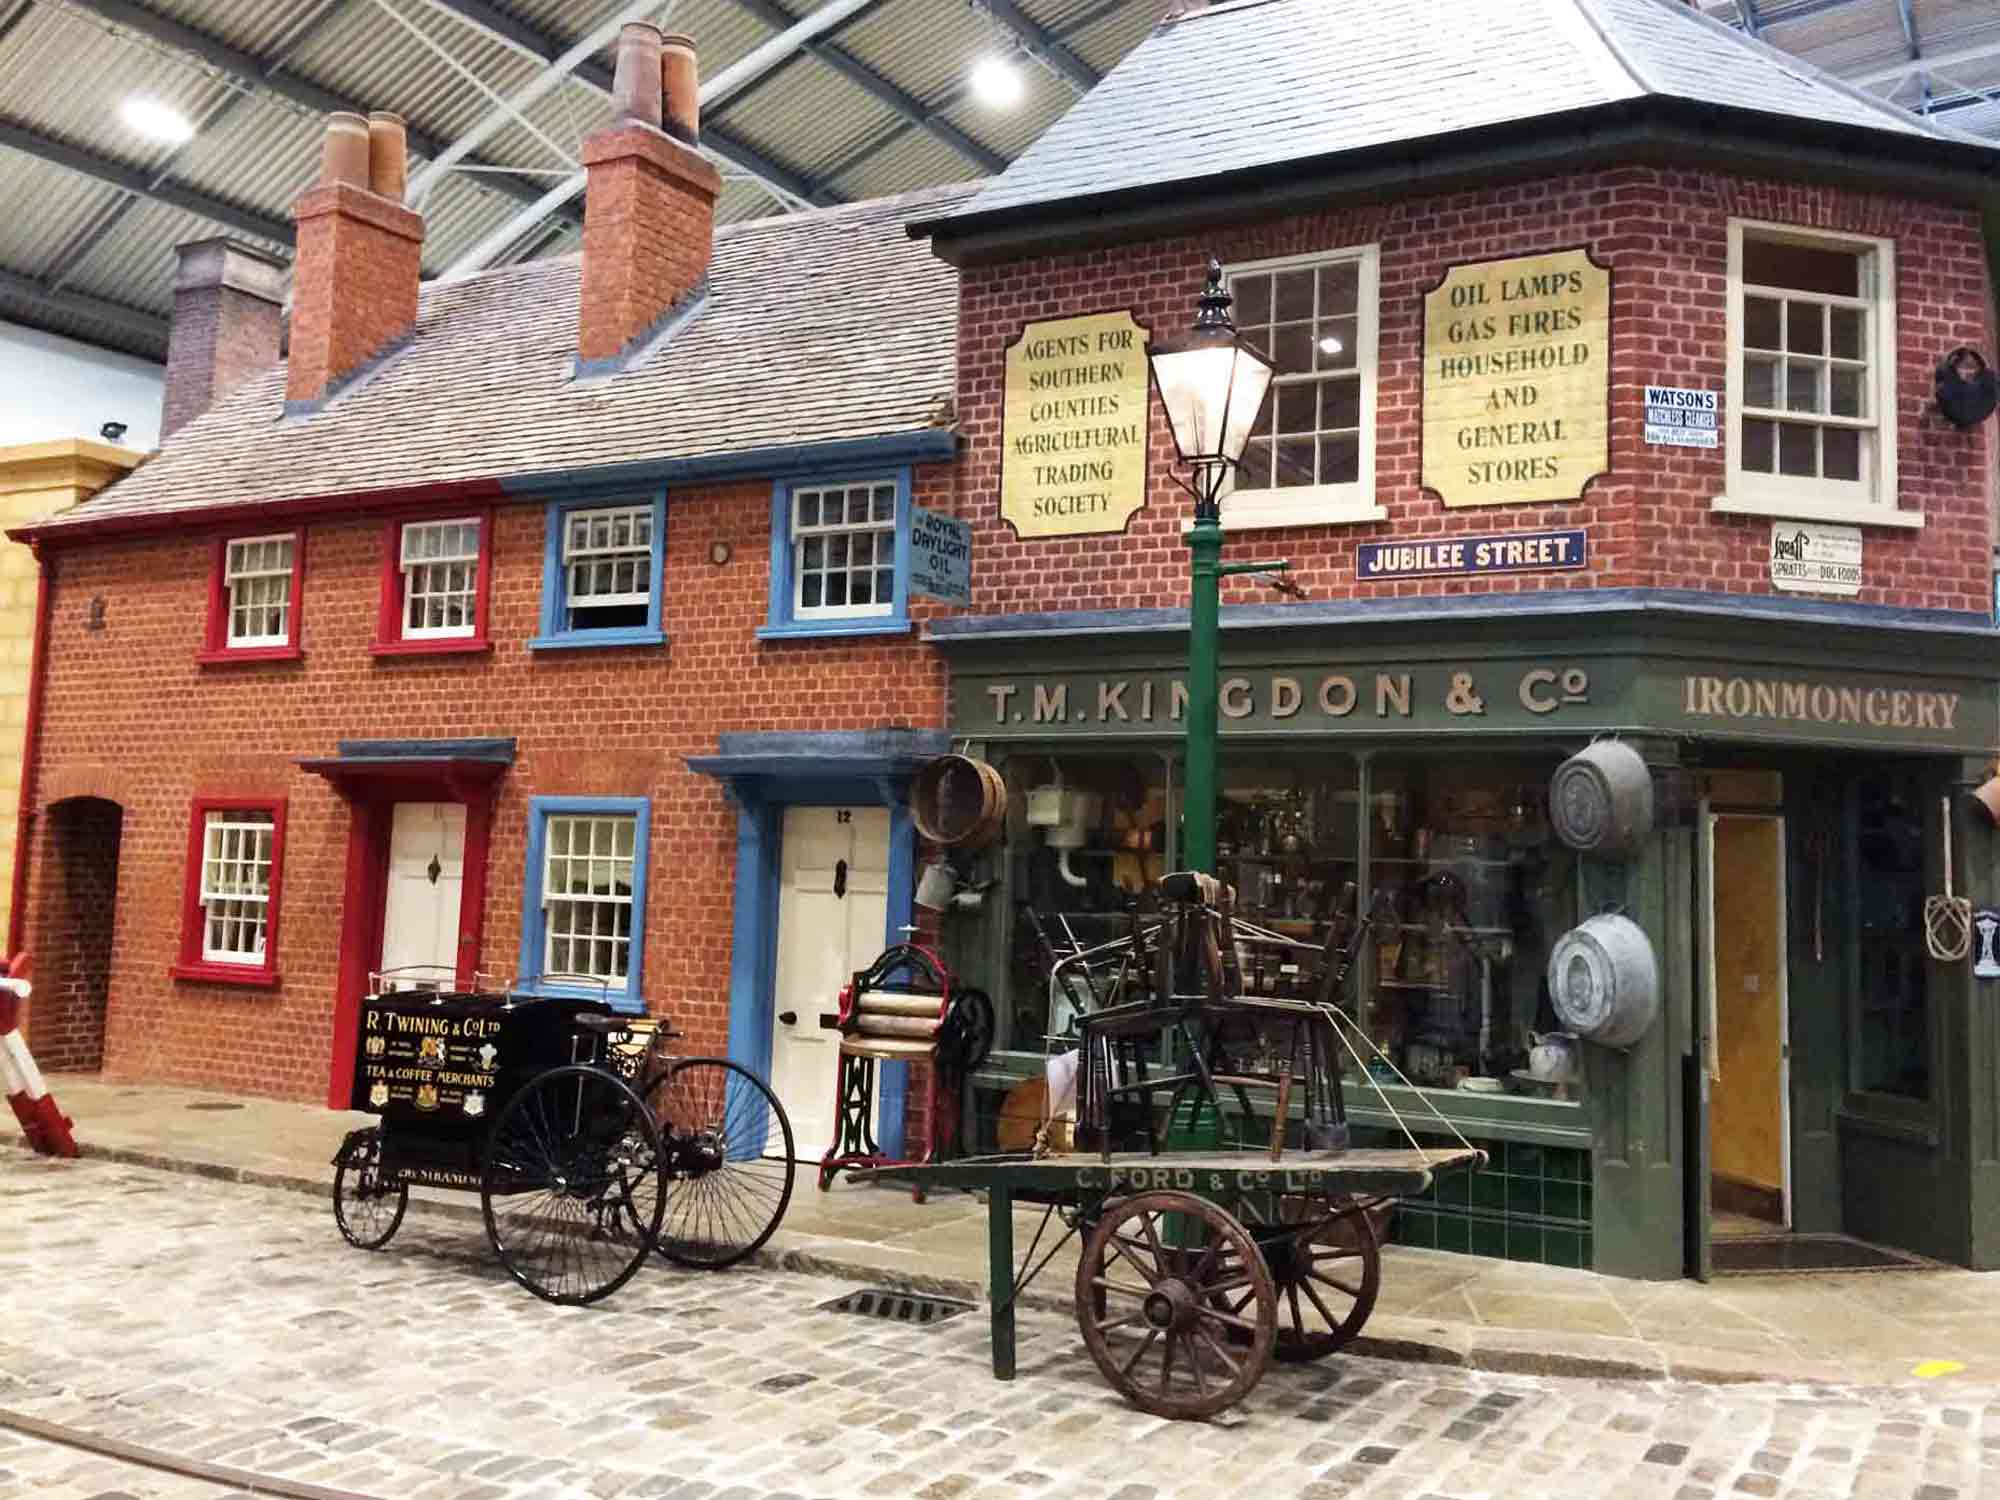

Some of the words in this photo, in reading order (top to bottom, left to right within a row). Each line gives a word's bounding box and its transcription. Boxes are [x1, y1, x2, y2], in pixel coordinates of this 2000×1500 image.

[1450, 283, 1490, 308] OIL
[1501, 271, 1583, 302] LAMPS
[1448, 316, 1497, 344] GAS
[1508, 307, 1582, 337] FIRES
[1023, 334, 1089, 362] AGENTS
[1099, 329, 1133, 352] FOR
[1440, 343, 1589, 379] HOUSEHOLD
[1029, 362, 1126, 391] SOUTHERN
[1030, 394, 1119, 422] COUNTIES
[1486, 385, 1537, 411] AND
[1014, 424, 1141, 455] AGRICULTURAL
[1457, 419, 1567, 450] GENERAL
[1034, 460, 1113, 486] TRADING
[1467, 456, 1560, 485] STORES
[1033, 493, 1111, 517] SOCIETY
[930, 554, 952, 575] OIL
[1369, 543, 1464, 572] JUBILEE
[1446, 672, 1485, 714] &
[1684, 676, 1960, 729] IRONMONGERY
[384, 1012, 449, 1036] TWINING
[452, 1023, 461, 1037] &
[367, 1064, 387, 1078] TEA
[395, 1067, 433, 1082] COFFEE
[436, 1071, 496, 1088] MERCHANTS
[1110, 1167, 1194, 1190] FORD
[1209, 1173, 1225, 1191] &
